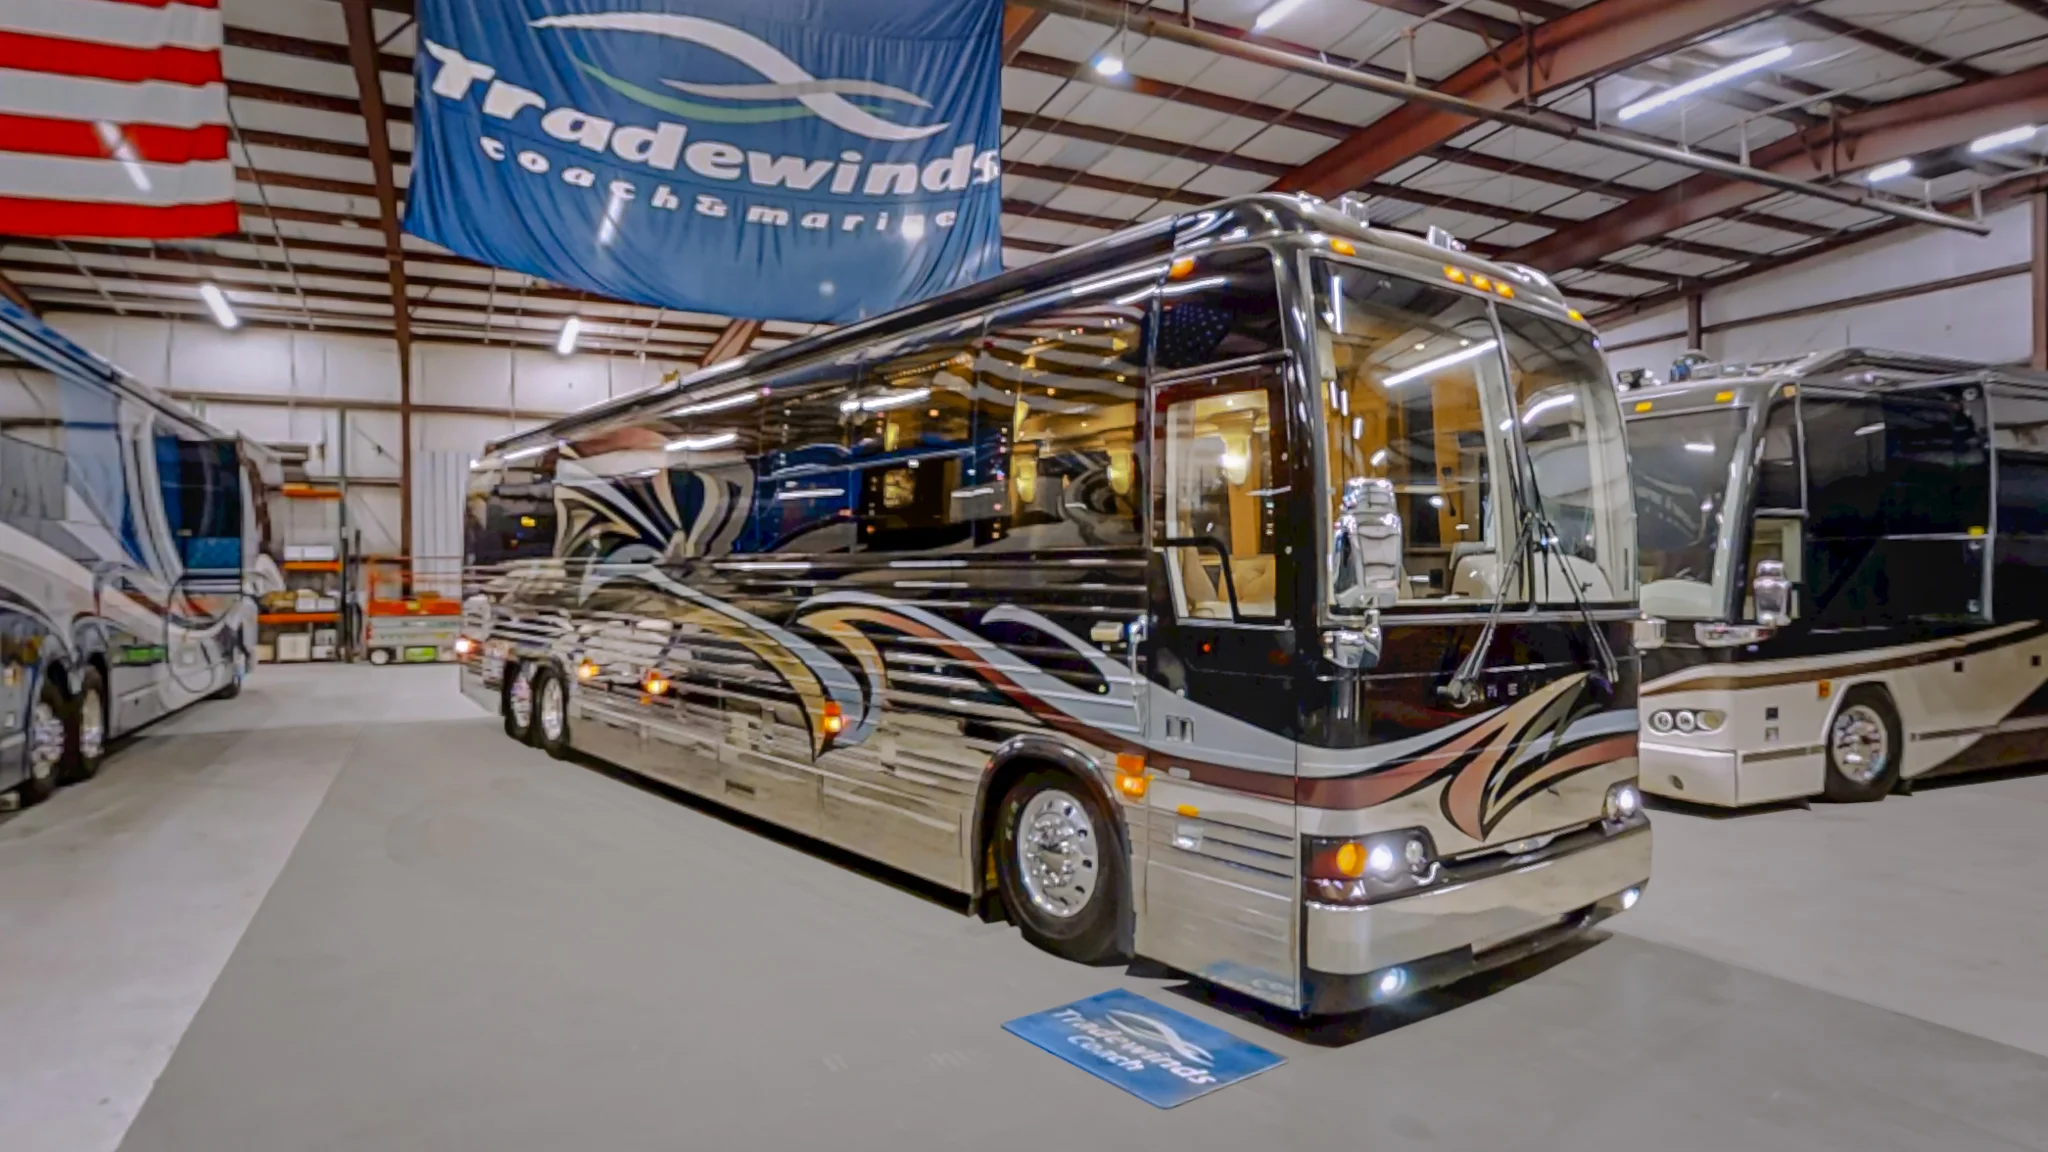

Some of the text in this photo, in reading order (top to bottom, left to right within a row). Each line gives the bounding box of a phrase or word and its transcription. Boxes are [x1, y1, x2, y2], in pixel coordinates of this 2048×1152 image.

[424, 40, 1000, 196] Tradewinds
[1052, 1008, 1216, 1084] Tradewinds
[1067, 1035, 1145, 1071] Coach
